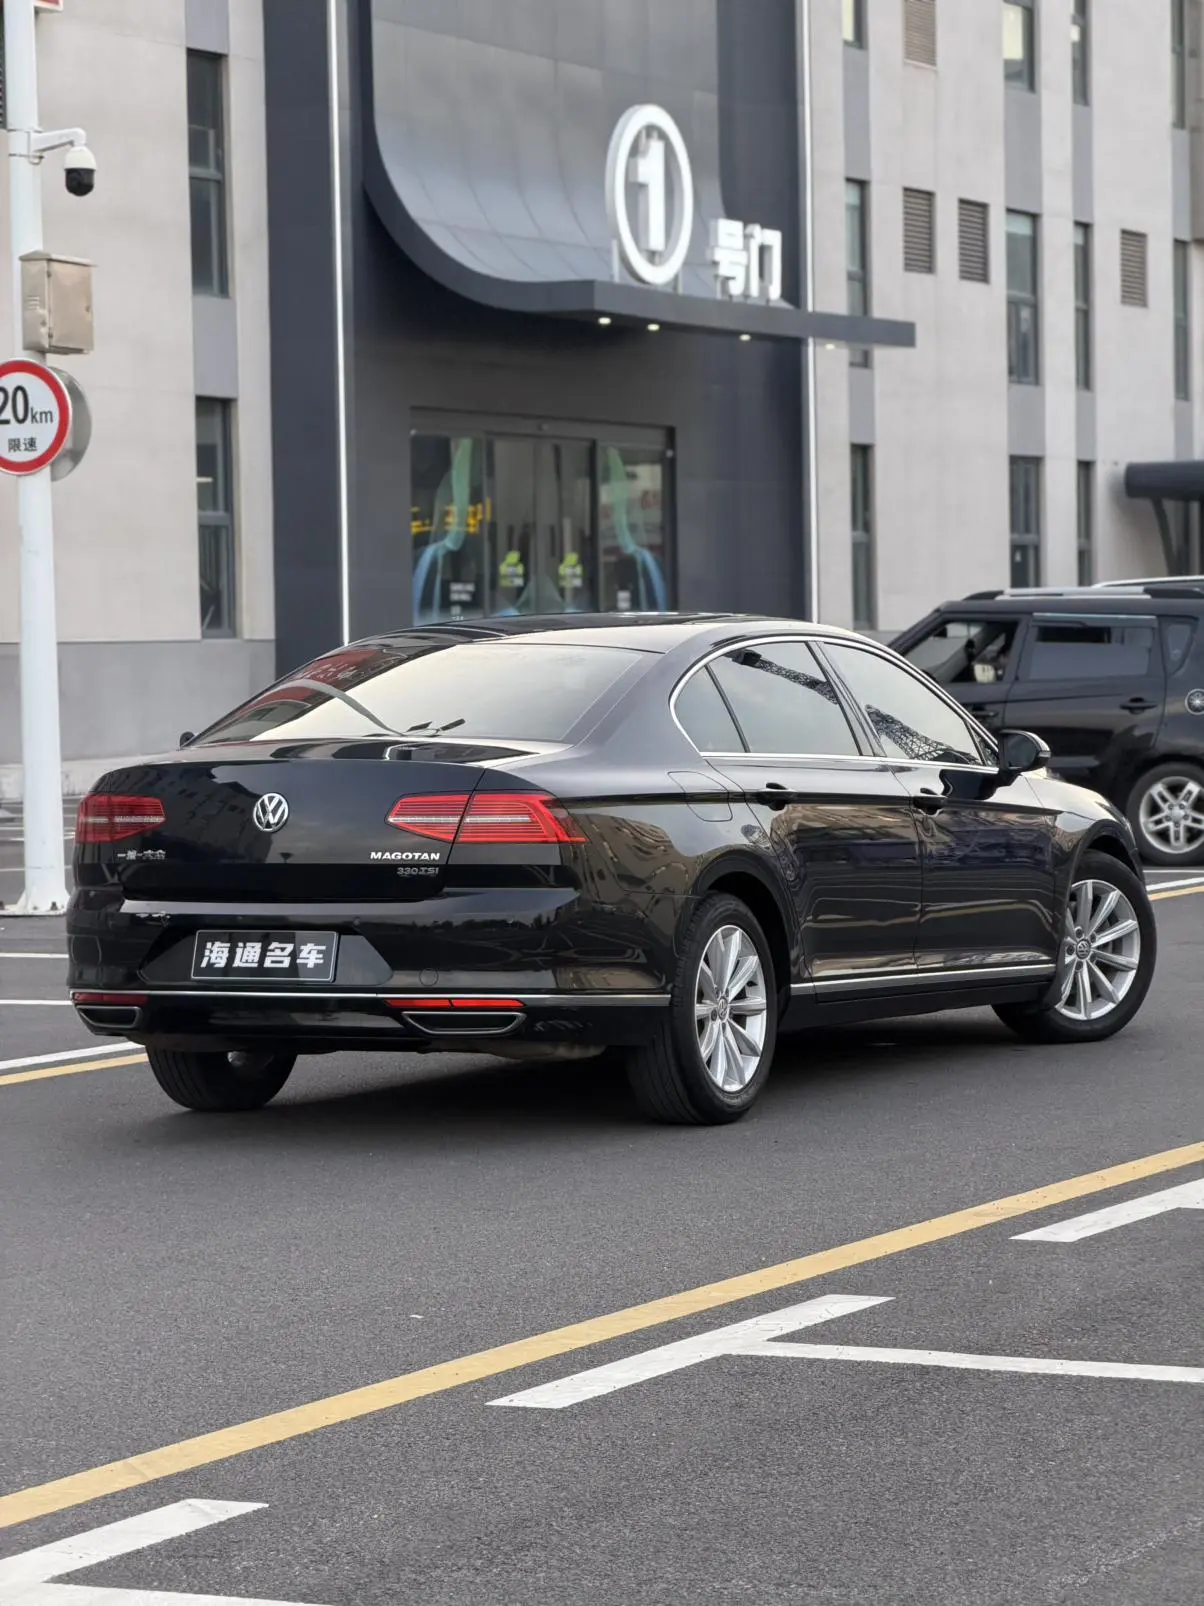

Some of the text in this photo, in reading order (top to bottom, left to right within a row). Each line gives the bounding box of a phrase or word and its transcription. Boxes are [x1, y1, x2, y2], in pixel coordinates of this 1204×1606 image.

[7, 437, 38, 453] 限速
[369, 851, 441, 861] MAGOTAN
[200, 941, 327, 969] 海通名车
